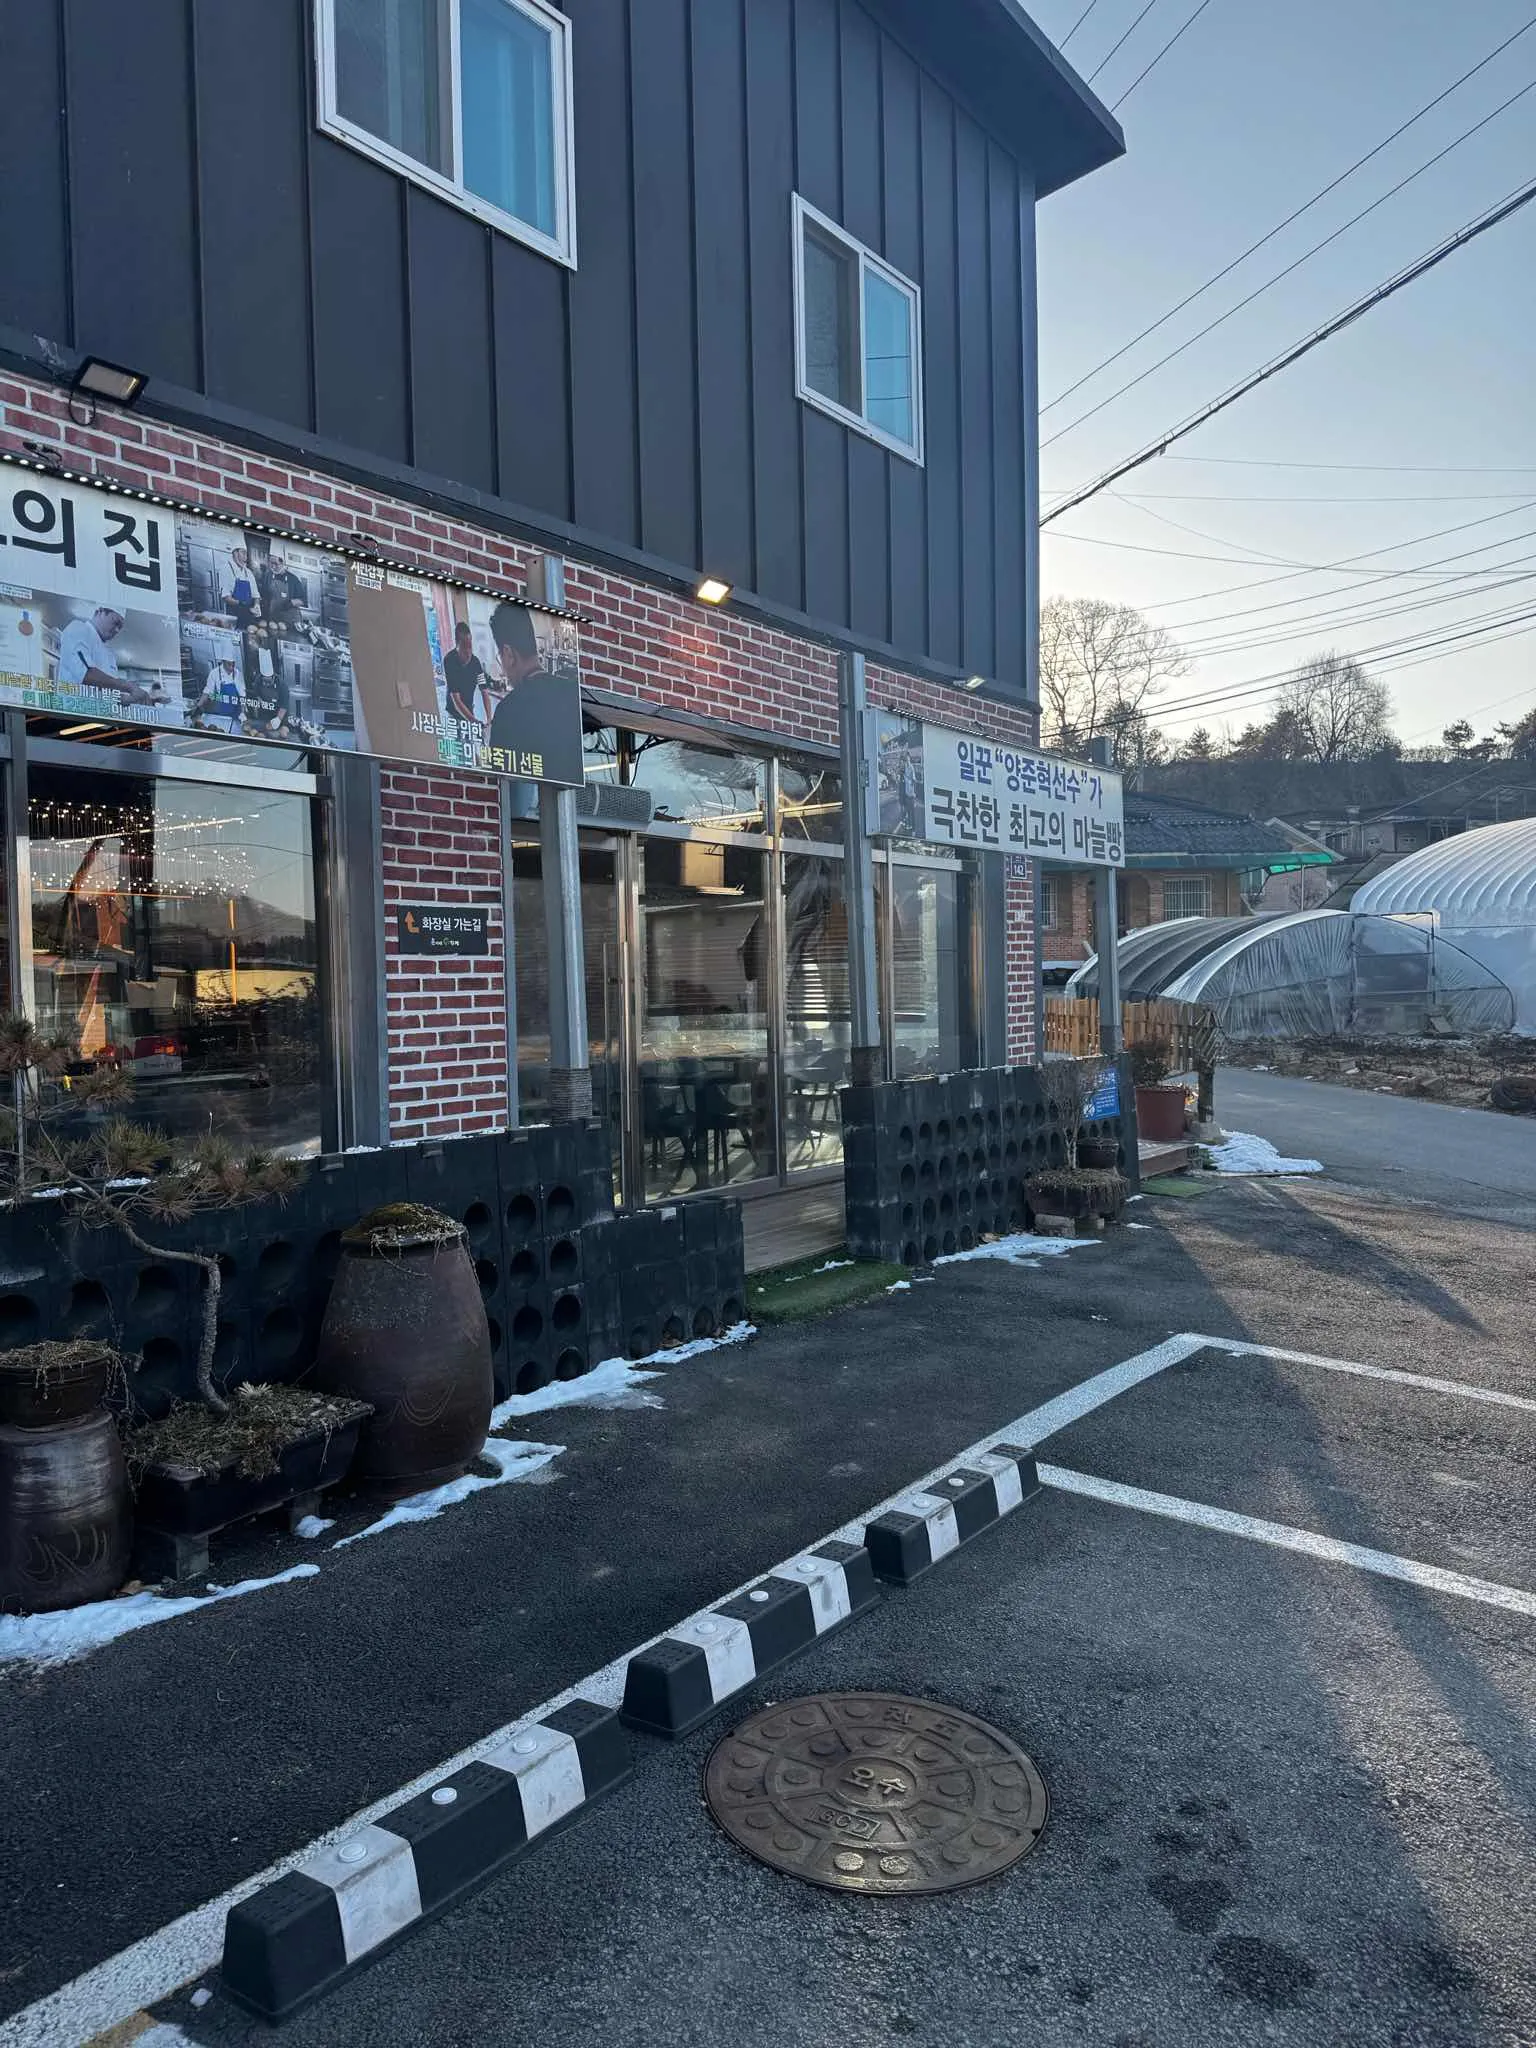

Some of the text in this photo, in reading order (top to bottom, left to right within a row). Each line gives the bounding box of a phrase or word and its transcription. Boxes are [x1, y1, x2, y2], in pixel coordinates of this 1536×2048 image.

[0, 489, 161, 592] 의 집
[411, 711, 483, 742] 사장님을 위한
[480, 745, 517, 773] 반죽기
[520, 752, 544, 777] 선물
[958, 741, 992, 785] 일꾼
[931, 787, 1122, 862] 극찬한 최고의 마늘빵
[422, 916, 481, 932] 화장실 가는길
[842, 1766, 907, 1796] 오수
